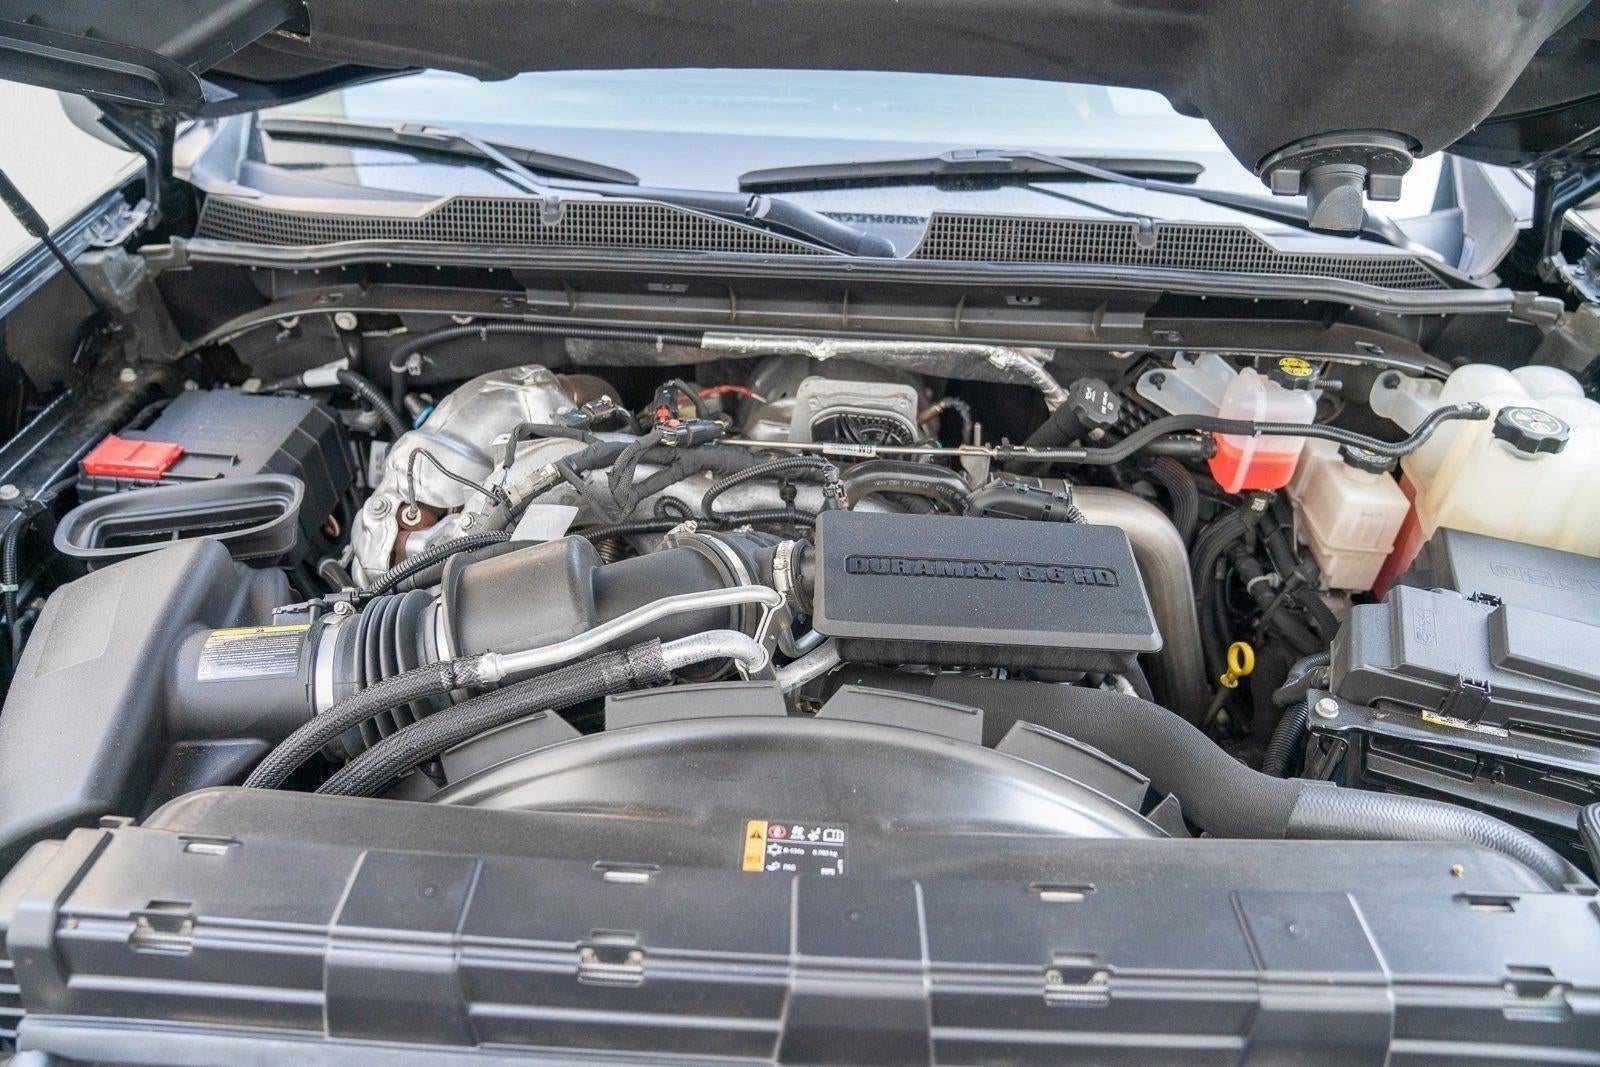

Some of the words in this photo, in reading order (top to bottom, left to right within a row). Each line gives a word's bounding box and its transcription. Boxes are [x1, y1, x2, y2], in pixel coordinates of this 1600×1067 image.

[851, 557, 1006, 580] DURAMAX
[1019, 563, 1067, 583] 6.6
[1072, 567, 1118, 587] HD
